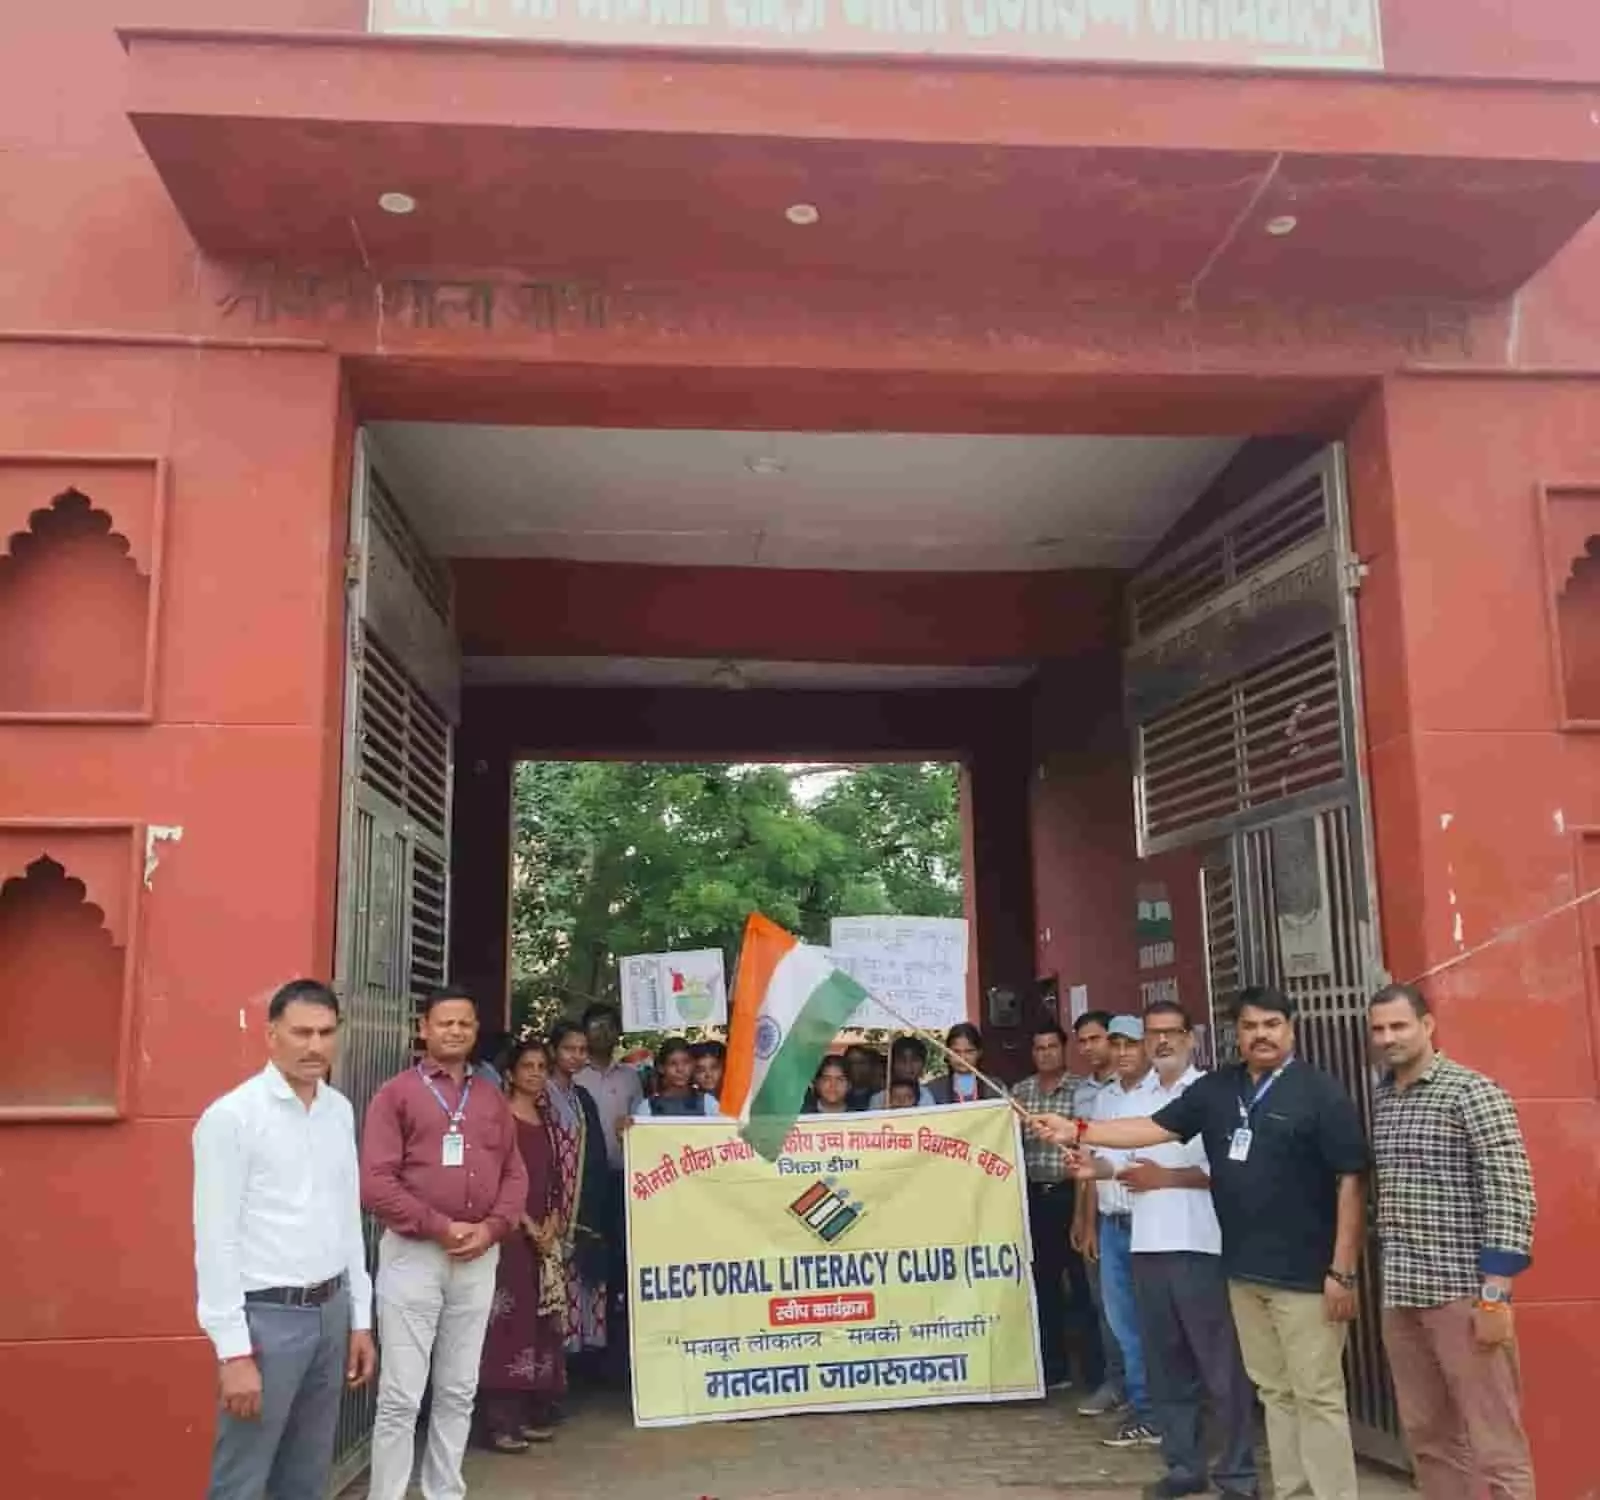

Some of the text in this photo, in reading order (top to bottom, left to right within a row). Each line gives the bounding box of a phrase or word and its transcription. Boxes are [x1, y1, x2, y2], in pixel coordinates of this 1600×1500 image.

[680, 1143, 716, 1177] शीला
[778, 1157, 821, 1176] जिला
[640, 1243, 1022, 1301] ELECTORAL LITERACY CLUB (ELC)
[846, 1319, 902, 1345] सबकी
[704, 1353, 969, 1398] मतदाता जागरूकता
